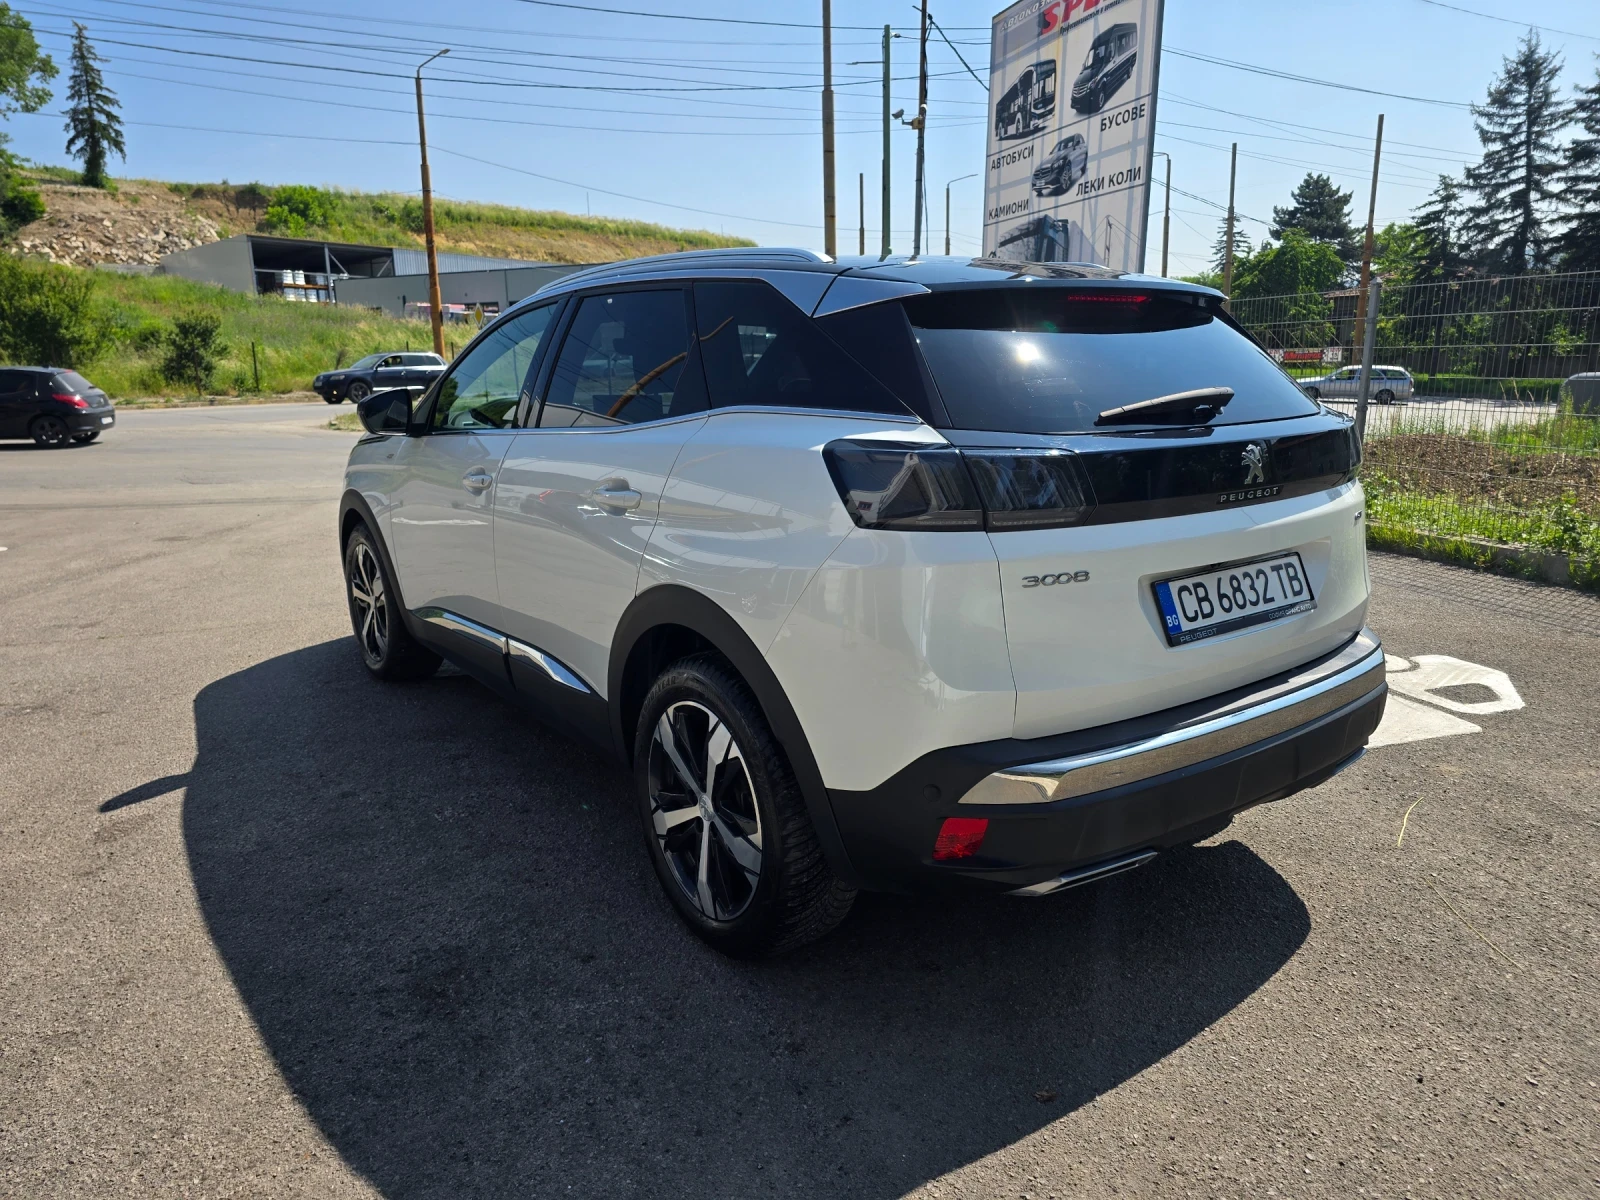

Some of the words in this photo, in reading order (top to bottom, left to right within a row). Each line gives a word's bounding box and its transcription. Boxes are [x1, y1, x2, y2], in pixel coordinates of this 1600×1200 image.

[1100, 103, 1146, 132] БУСОВЕ
[991, 145, 1034, 171] АВТОБУСИ
[1076, 176, 1105, 197] ЛЕКИ
[1108, 166, 1142, 188] КОЛИ
[989, 199, 1029, 220] КАМИОНИ
[1220, 487, 1279, 503] PEUGEOT
[1021, 570, 1091, 589] 3008
[1177, 581, 1215, 623] CB
[1216, 568, 1276, 614] 6832
[1270, 562, 1304, 600] TB
[1166, 614, 1180, 628] BG
[1180, 627, 1218, 643] PEUGEOT
